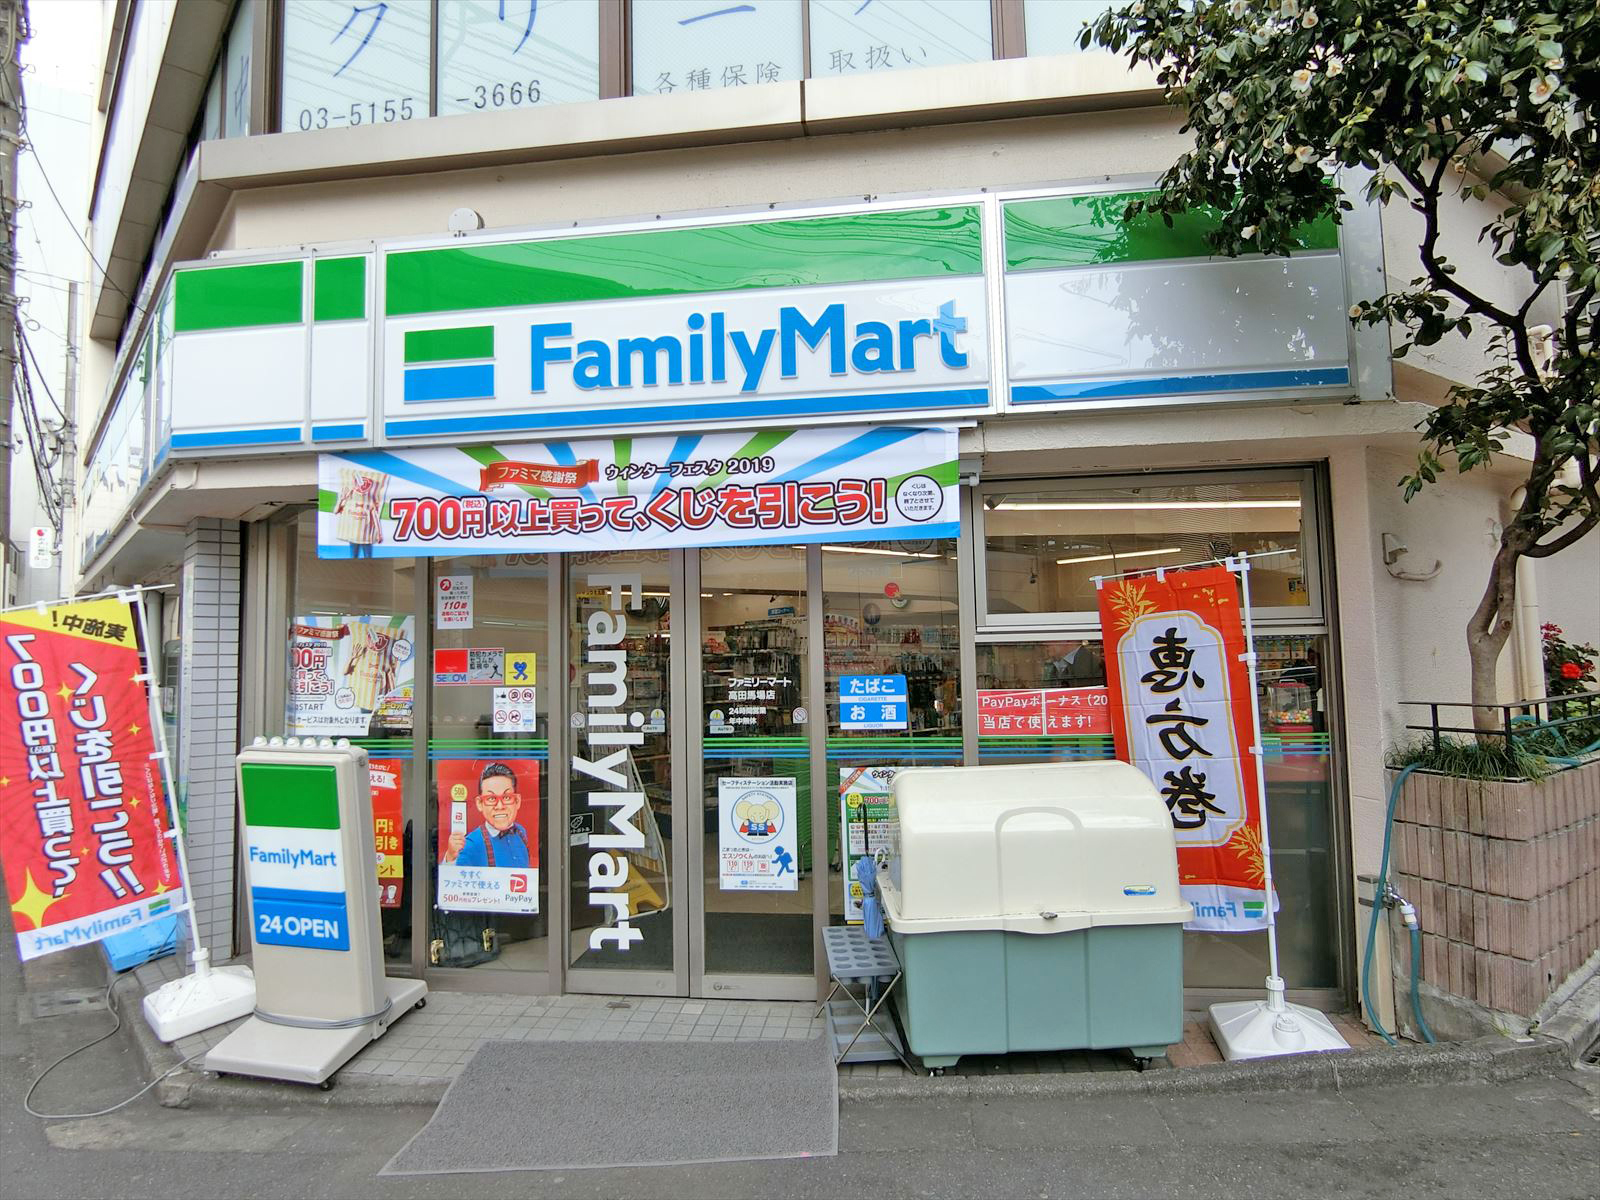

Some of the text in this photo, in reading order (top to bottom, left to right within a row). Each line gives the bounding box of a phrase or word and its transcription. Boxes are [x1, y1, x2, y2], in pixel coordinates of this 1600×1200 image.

[654, 45, 928, 94] 各種保険 取扱い
[299, 80, 541, 131] 03-5155 -3666
[529, 299, 969, 393] FamilyMart
[497, 465, 577, 485] ファミマ感謝祭
[605, 456, 775, 480] ウィンターフェスタ 2019
[727, 677, 792, 687] ファミリーマート
[849, 678, 896, 694] たばこ
[572, 573, 645, 951] FamilyMart
[249, 846, 337, 869] FamilyMart
[505, 894, 533, 904] PayPay
